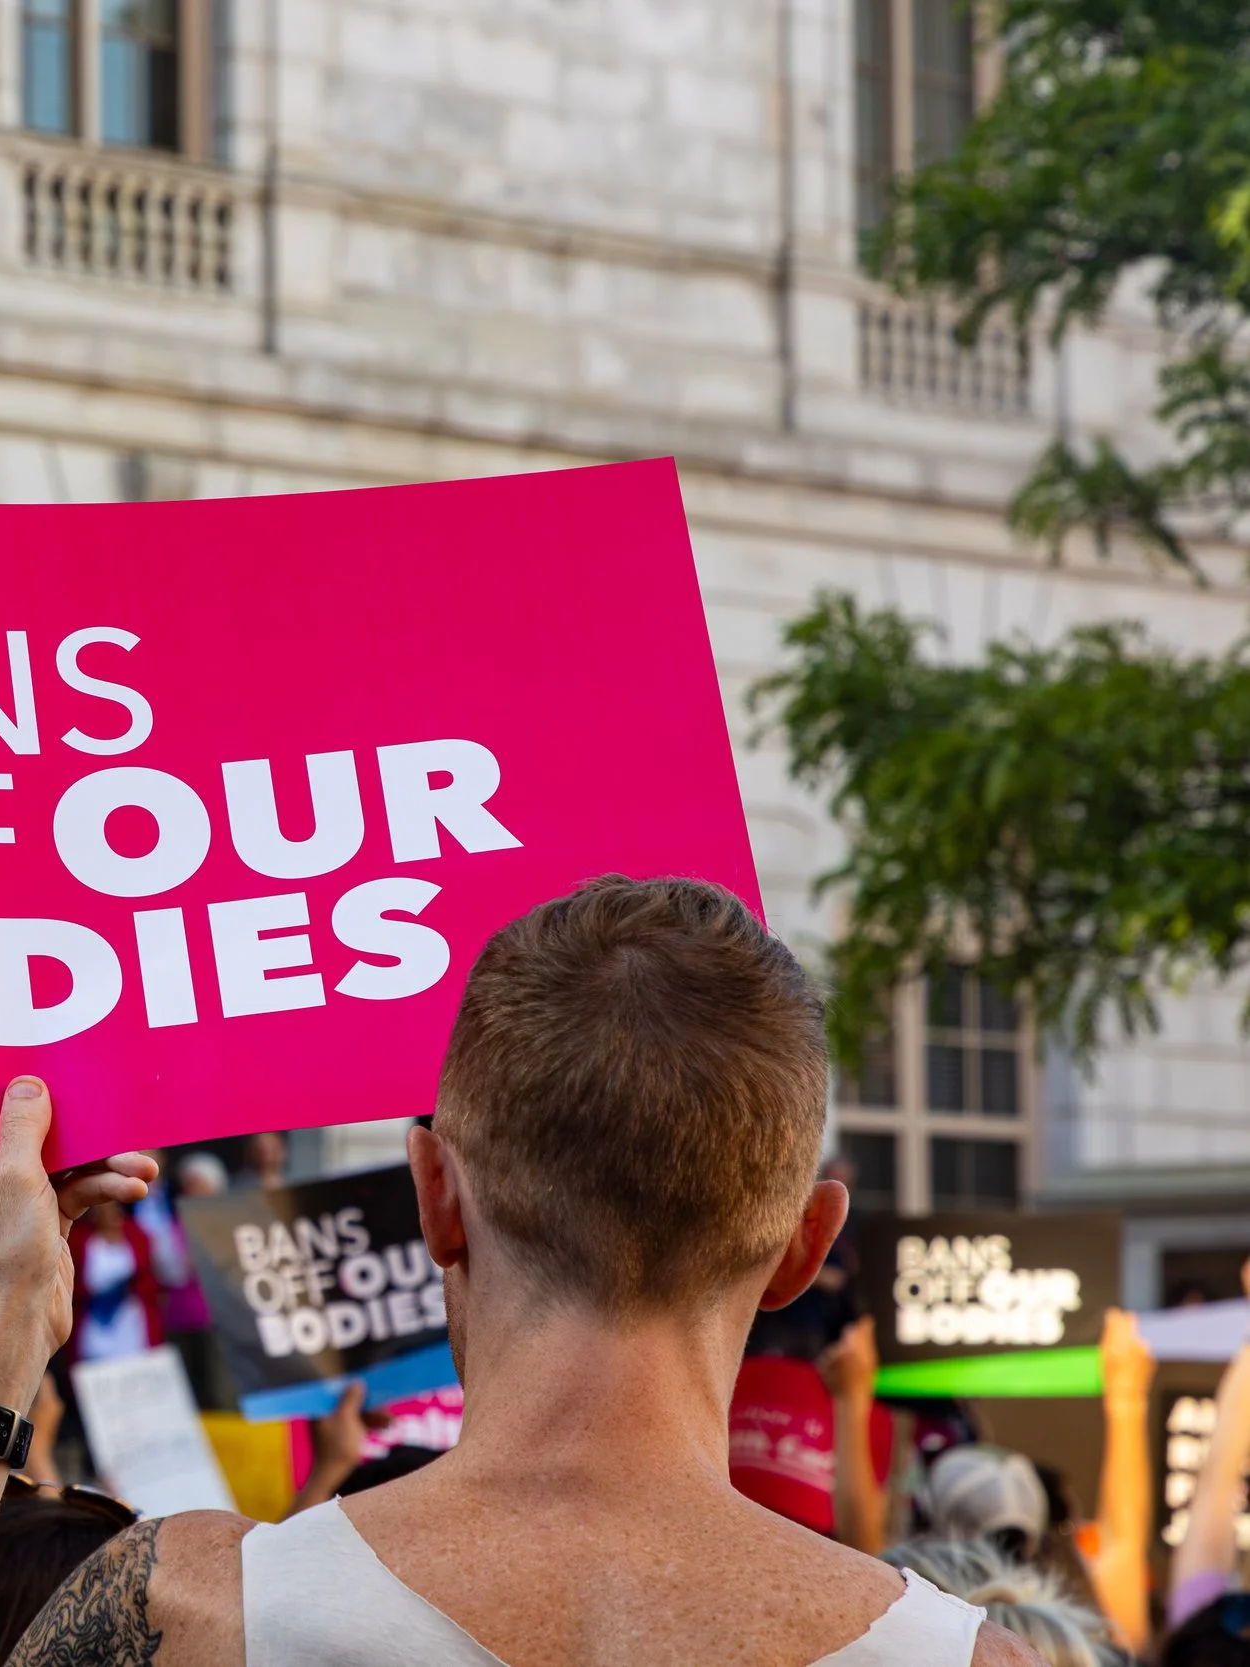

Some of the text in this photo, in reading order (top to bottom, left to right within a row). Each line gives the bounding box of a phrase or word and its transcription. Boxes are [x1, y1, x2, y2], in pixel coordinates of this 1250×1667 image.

[53, 738, 525, 898] OUR
[234, 1207, 370, 1272] BANS
[896, 1235, 1012, 1274] BANS
[244, 1240, 444, 1314] OFF OU
[894, 1270, 979, 1308] OFF
[256, 1285, 448, 1357] BODIES
